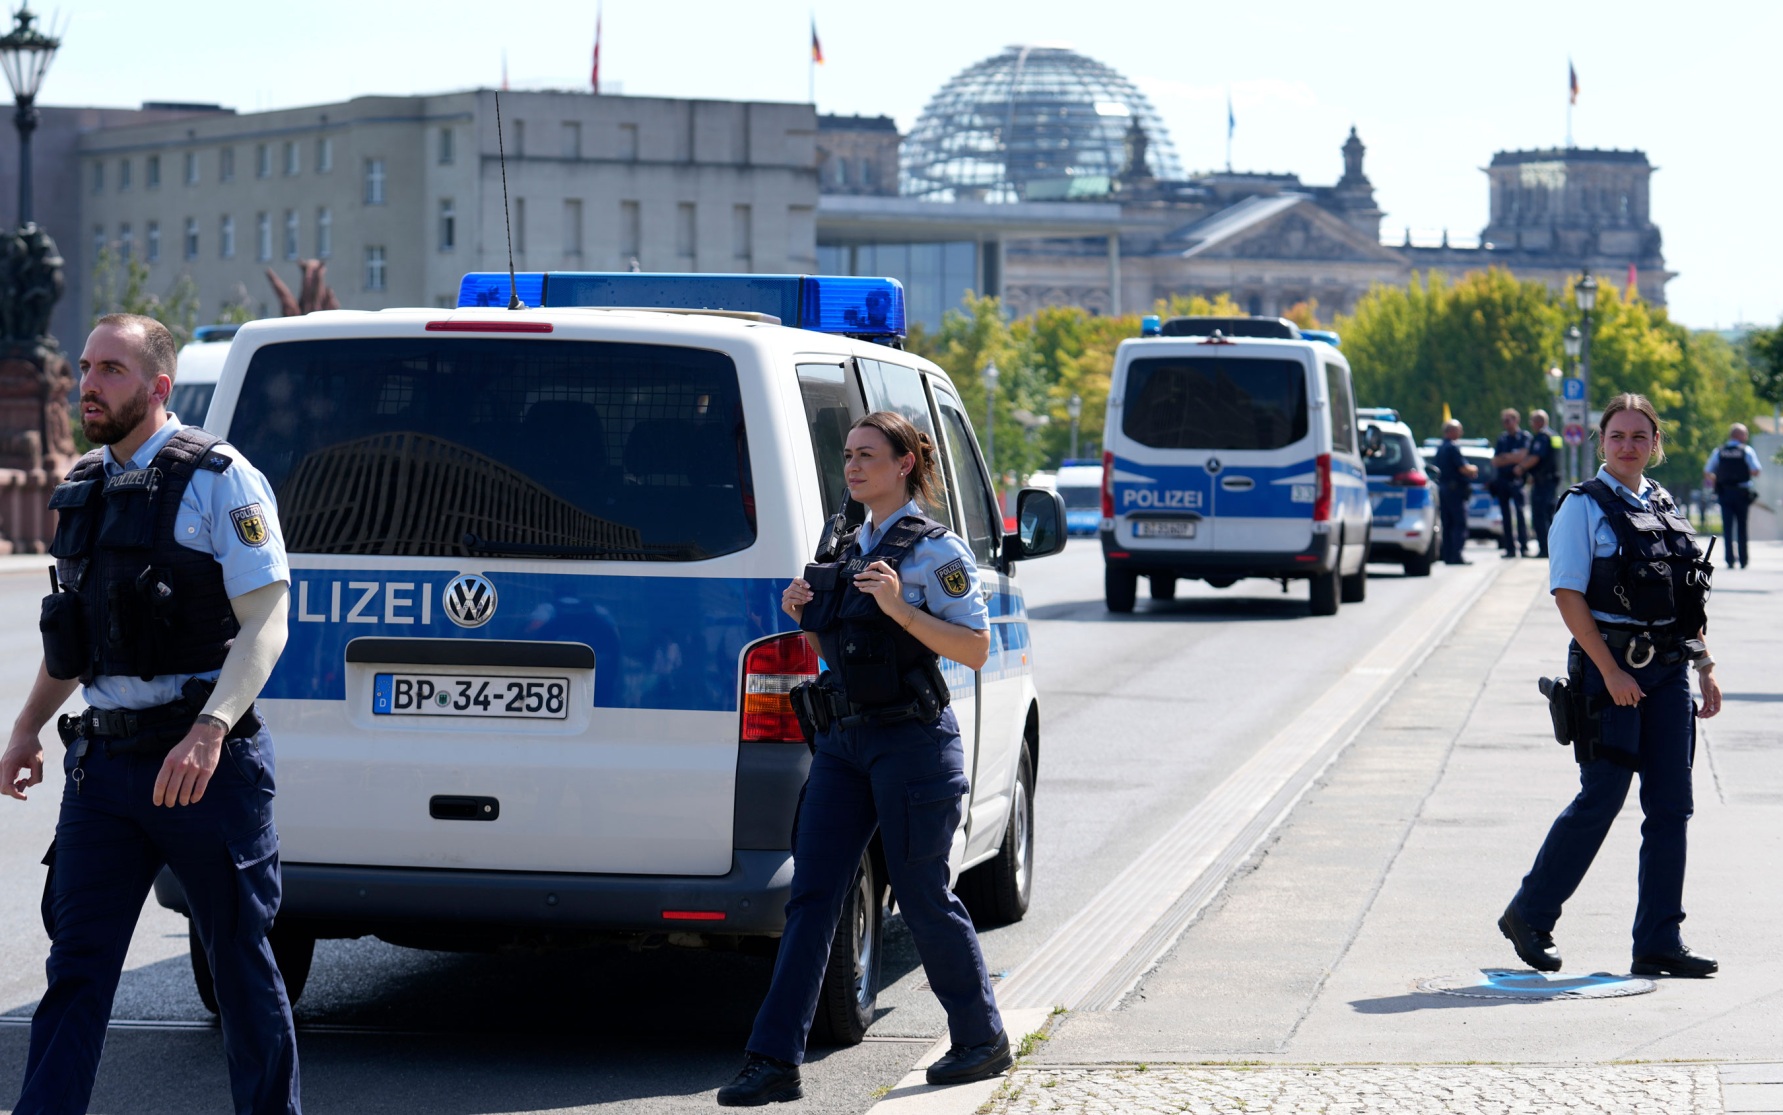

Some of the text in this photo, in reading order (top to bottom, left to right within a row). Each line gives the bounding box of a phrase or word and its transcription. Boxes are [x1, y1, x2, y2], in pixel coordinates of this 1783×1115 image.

[107, 470, 149, 489] POLIZEI
[1123, 489, 1203, 509] POLIZEI
[847, 558, 870, 572] POLI
[938, 561, 962, 578] POLIZEI
[286, 580, 432, 625] LIZEI
[394, 679, 435, 710] BP
[453, 681, 565, 714] 34-258
